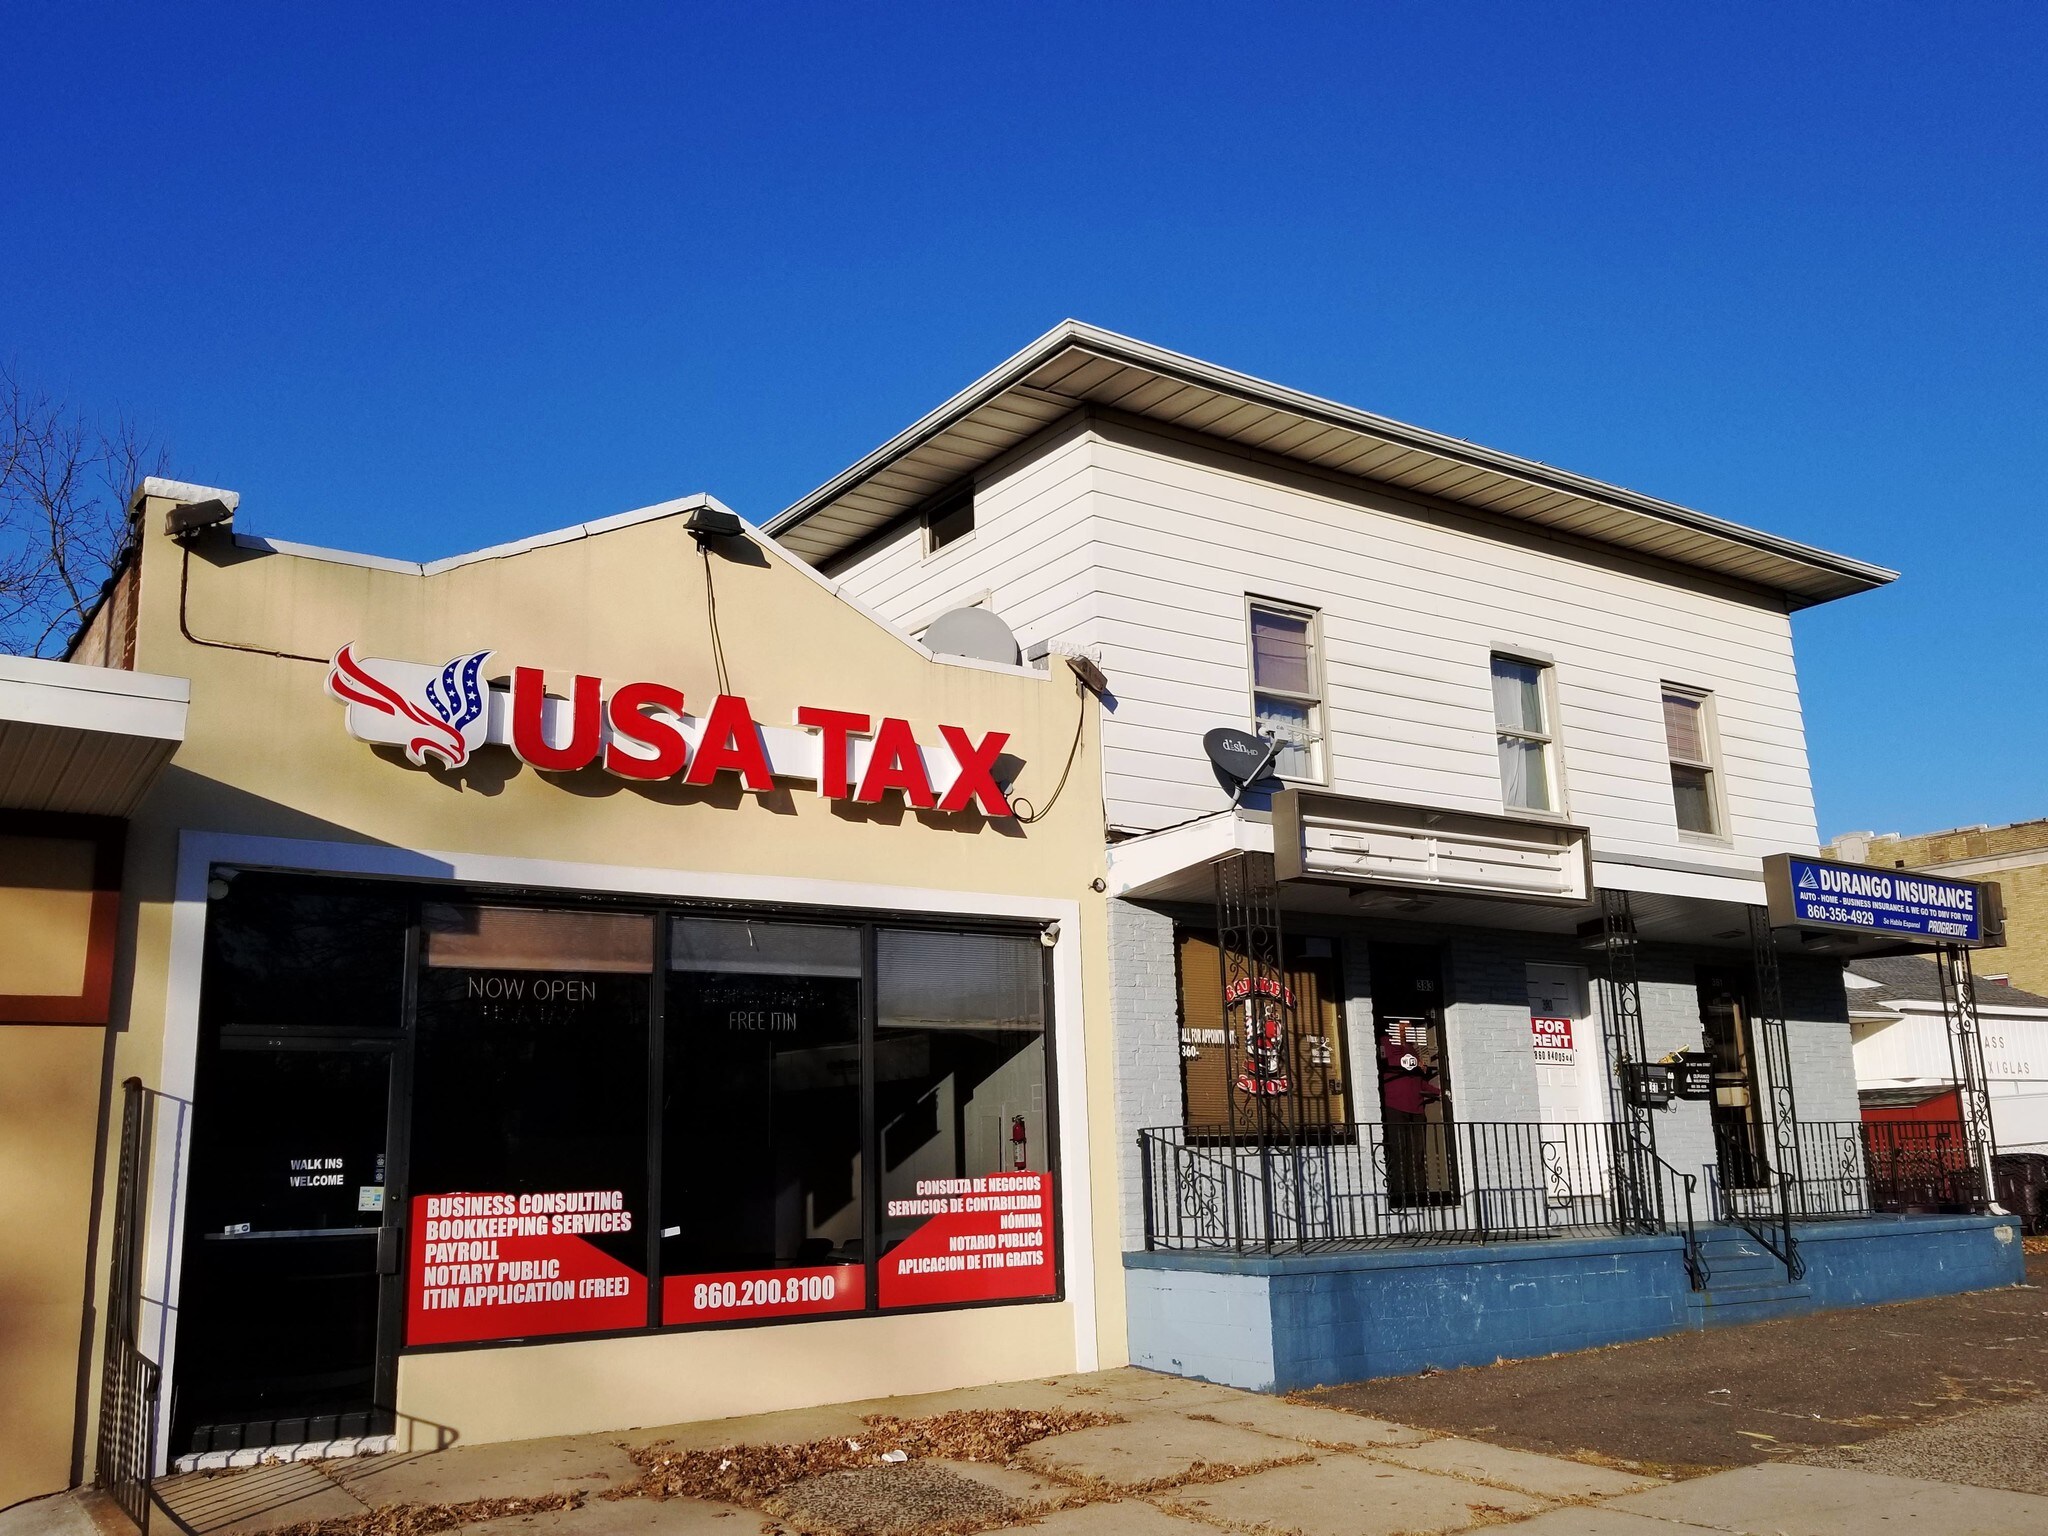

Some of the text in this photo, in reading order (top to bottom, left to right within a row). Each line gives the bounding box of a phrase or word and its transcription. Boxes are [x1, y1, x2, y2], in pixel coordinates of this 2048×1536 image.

[510, 666, 1013, 817] USA TAX
[1223, 739, 1246, 752] dish
[1819, 868, 1975, 912] DURANGO INSURANCE
[1800, 892, 1816, 901] AUTO
[1821, 894, 1838, 904] HOME
[1843, 897, 1871, 909] BUSINESS
[1872, 901, 1904, 913] INSURANCE
[1905, 905, 1910, 913] &
[1911, 906, 1920, 914] WE
[1920, 908, 1929, 916] GO
[1929, 909, 1937, 917] TO
[1938, 911, 1949, 919] DMV
[1951, 912, 1961, 920] FOR
[1962, 913, 1973, 922] YOU
[1807, 904, 1874, 925] 860-356-4929
[1928, 920, 1968, 937] PROGRESSIVE
[468, 976, 596, 1001] NOW OPEN
[729, 1011, 797, 1031] FREE ITIN
[1535, 1020, 1565, 1034] FOR
[1191, 1028, 1201, 1043] FOR
[1533, 1033, 1571, 1048] RENT
[290, 1158, 343, 1170] WALK INS
[290, 1174, 344, 1187] WELCOME
[916, 1176, 1041, 1196] CONSULTA DE NEGOCIOS
[427, 1191, 623, 1218] BUSINESS CONSULTING
[888, 1195, 1042, 1216] SERVICIOS DE CONTABILIDAD
[426, 1211, 632, 1241] BOOKKEEPING SERVICES
[1000, 1212, 1042, 1229] NÓMINA
[950, 1229, 1043, 1251] NOTARIO PUBLICÓ
[425, 1240, 499, 1263] PAYROLL
[423, 1259, 560, 1286] NOTARY PUBLIC
[898, 1250, 1044, 1275] APLICACION DE ITIN GRATIS
[423, 1276, 630, 1310] ITIN APPLICATION (FREE)
[693, 1275, 835, 1310] 860.200.8100
